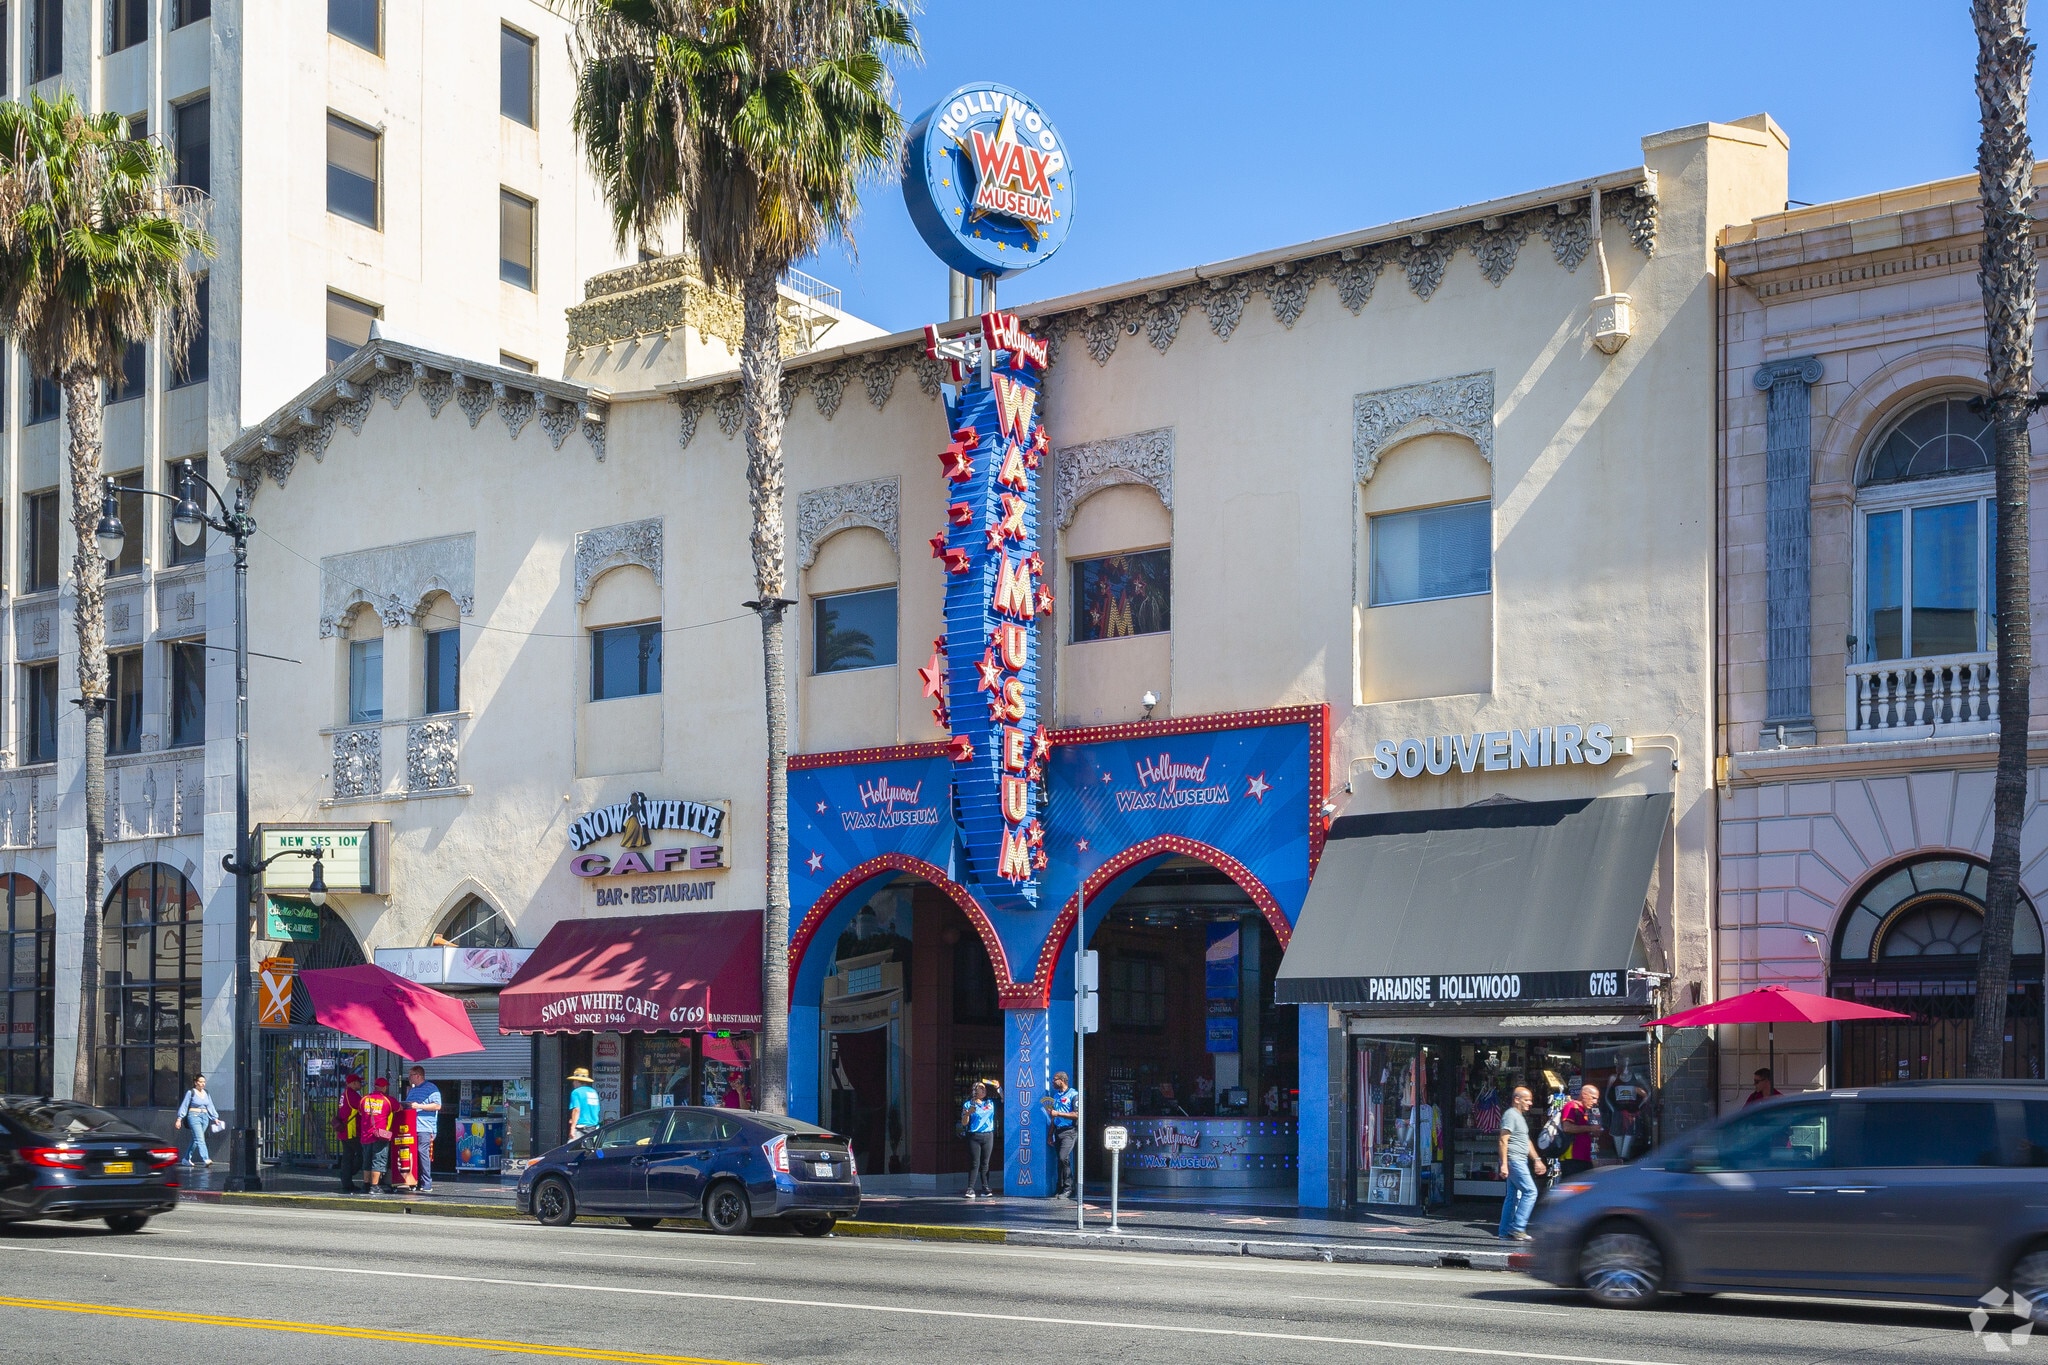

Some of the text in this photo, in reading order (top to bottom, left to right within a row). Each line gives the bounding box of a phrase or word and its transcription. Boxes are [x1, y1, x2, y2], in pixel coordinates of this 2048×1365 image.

[938, 91, 1065, 172] HOLLYWOOD
[970, 129, 1054, 199] WAX
[976, 186, 1053, 224] MUSEUM
[981, 311, 1048, 370] Hollywood
[992, 373, 1036, 887] WAX MUSEUM
[1372, 723, 1613, 780] SOUVENIRS
[1136, 753, 1210, 792] Hollywood
[859, 777, 922, 806] Hollywood
[1116, 785, 1230, 812] WAX MUSEUM
[567, 801, 725, 850] SNOW WHITE
[842, 807, 938, 830] WAX MUSEUM
[280, 836, 304, 847] NEW
[339, 836, 358, 847] ION
[570, 845, 723, 877] CAFE
[1369, 972, 1618, 1001] PARADISE HOLLYWOOD 6765
[542, 996, 578, 1023] SNOW
[581, 993, 623, 1011] WHITE
[626, 996, 660, 1021] CAFE
[669, 1006, 705, 1023] 6769
[574, 1013, 626, 1024] SINCE 1946
[598, 1090, 618, 1102] 946
[1015, 1013, 1035, 1186] WAX MUSEUM
[1152, 1124, 1200, 1154] Hollywood
[1144, 1153, 1218, 1169] WAX MUSEUM
